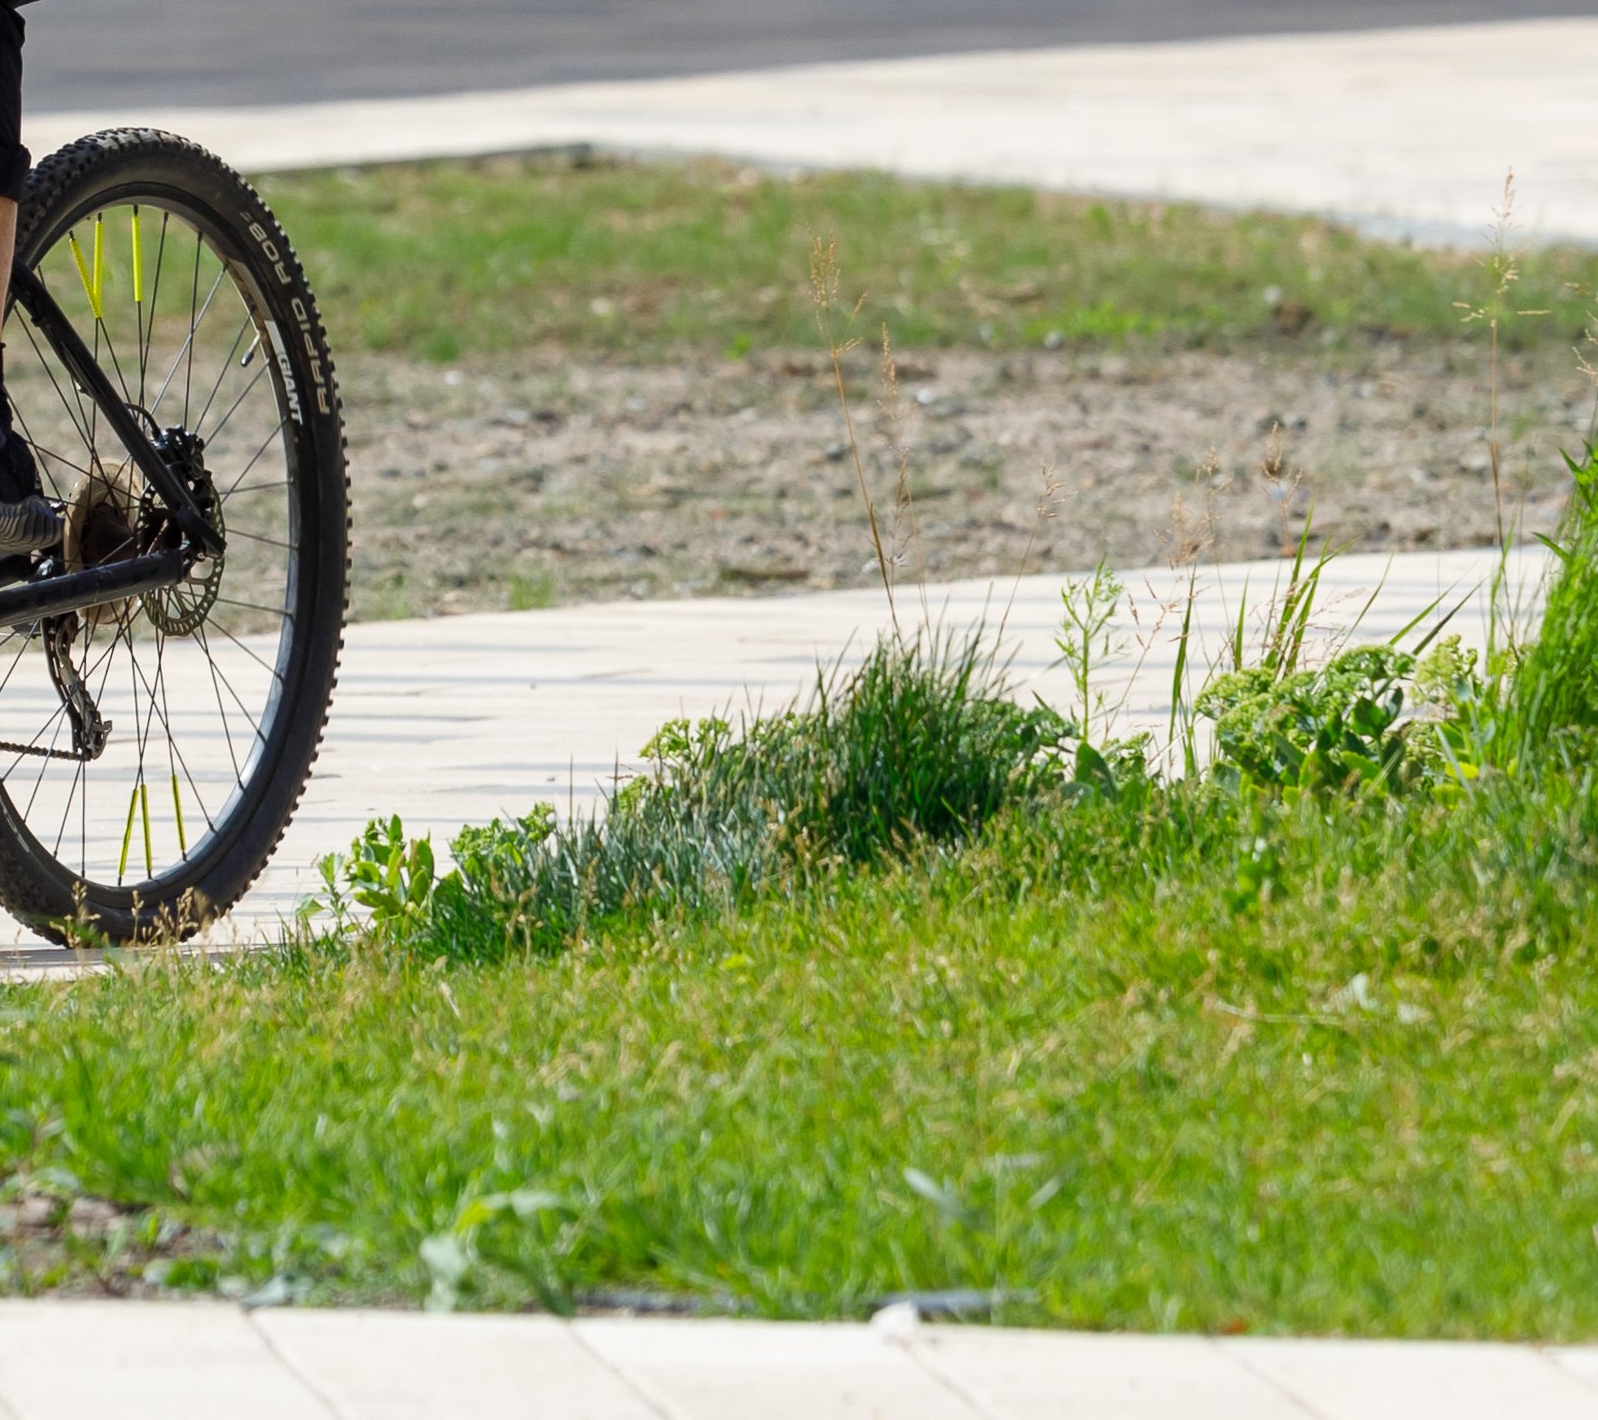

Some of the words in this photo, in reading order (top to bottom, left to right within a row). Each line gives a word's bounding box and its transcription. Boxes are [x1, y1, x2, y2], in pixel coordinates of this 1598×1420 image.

[248, 221, 291, 285] ROB
[276, 352, 304, 426] GIANT
[291, 297, 330, 415] RAPID
